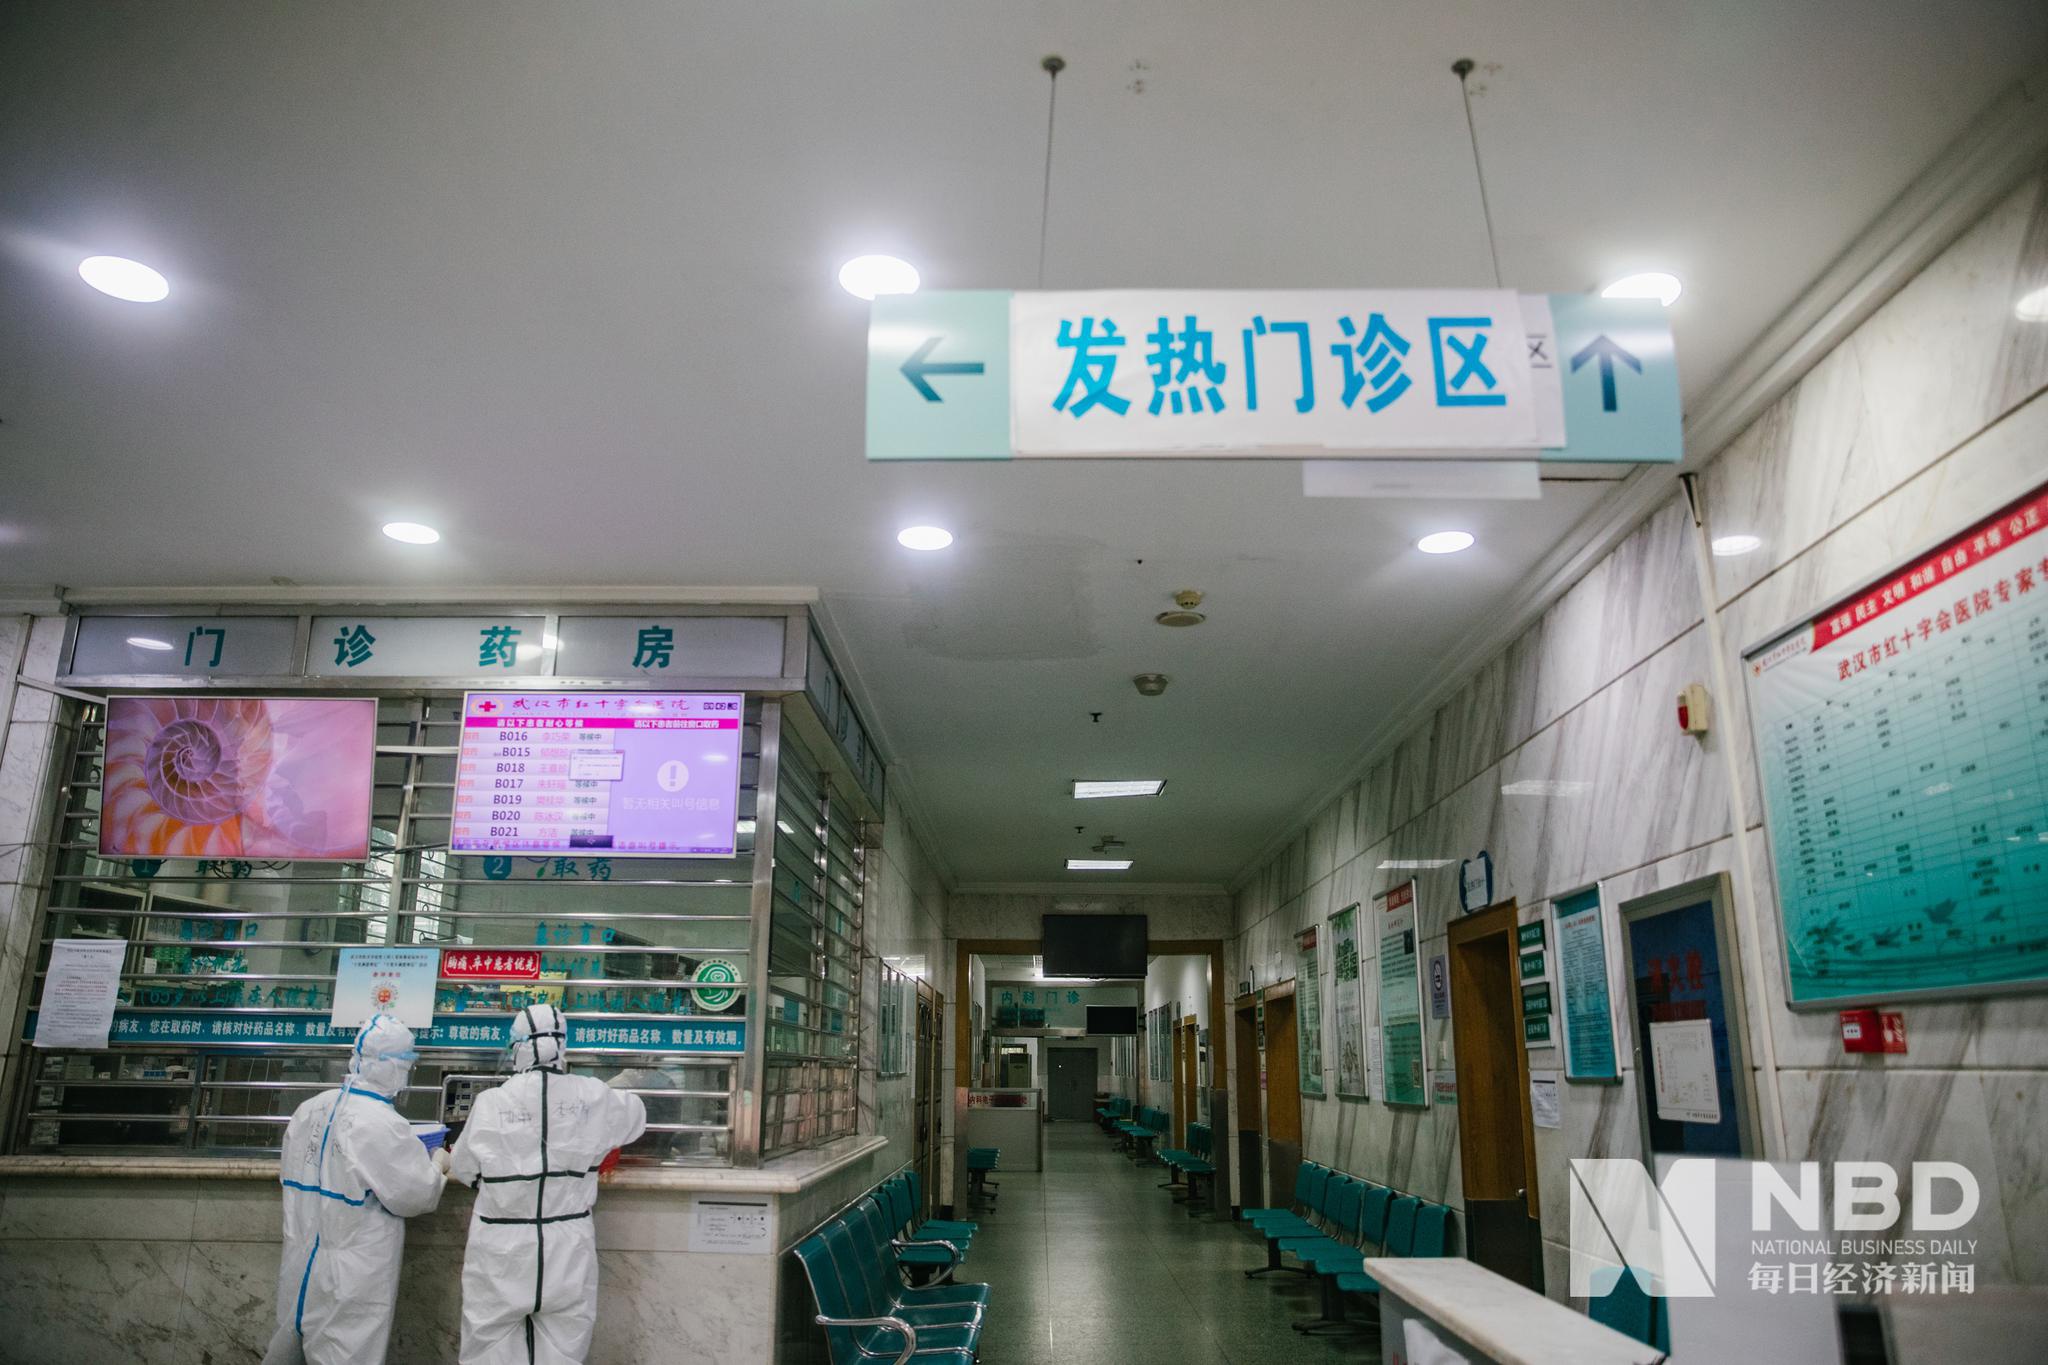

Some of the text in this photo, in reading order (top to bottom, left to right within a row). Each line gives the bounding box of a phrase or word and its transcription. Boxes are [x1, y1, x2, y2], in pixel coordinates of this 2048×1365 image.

[1052, 313, 1507, 419] 发热门诊区
[1855, 599, 1878, 622] 民主
[1882, 580, 1906, 608] 文明
[1909, 565, 1936, 592] 和谐
[1940, 548, 1968, 575] 自由
[1973, 526, 2002, 556] 平等
[2009, 507, 2039, 537] 公正
[499, 731, 528, 742] B016
[502, 747, 531, 758] B015
[496, 763, 526, 774] B018
[494, 779, 524, 789] B017
[493, 795, 523, 805] B019
[491, 811, 521, 821] B020
[490, 826, 519, 837] B021
[491, 857, 503, 875] 2
[1001, 990, 1080, 1005] 内科门诊
